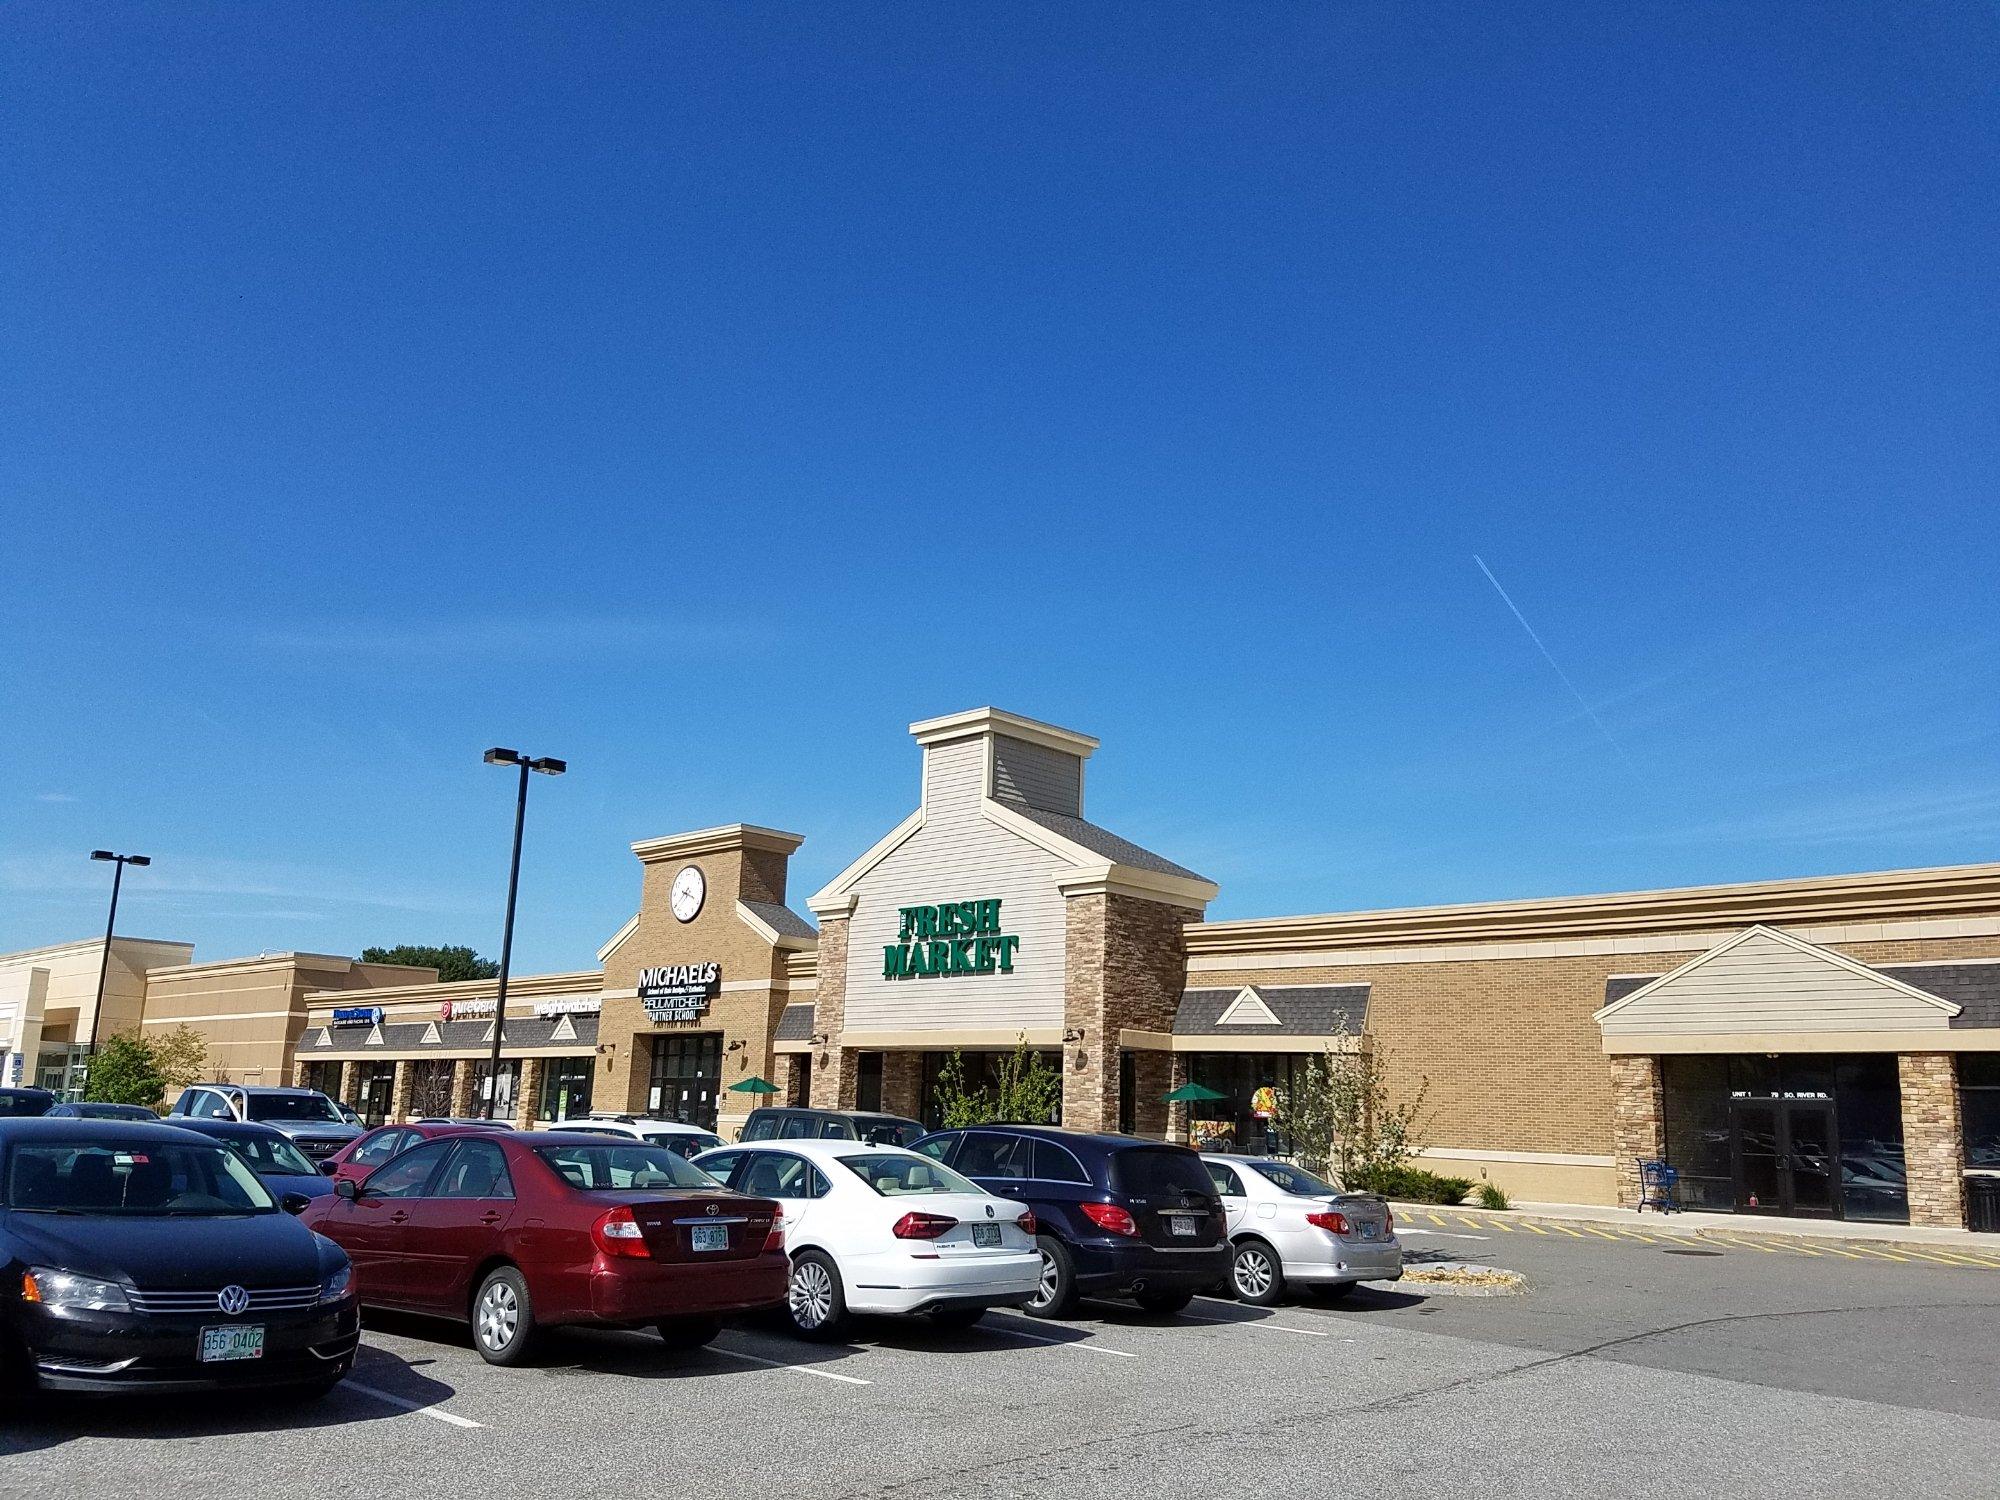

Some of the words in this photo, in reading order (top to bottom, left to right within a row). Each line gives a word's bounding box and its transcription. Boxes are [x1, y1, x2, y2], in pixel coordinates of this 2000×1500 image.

[898, 898, 1002, 938] FRESH
[882, 935, 1019, 976] MARKET
[639, 962, 717, 988] MICHAEL'S
[647, 987, 660, 995] School
[649, 1010, 672, 1021] PARTNER
[675, 1009, 697, 1020] SCHOOL
[204, 1334, 226, 1350] 356
[233, 1332, 262, 1349] 0402
